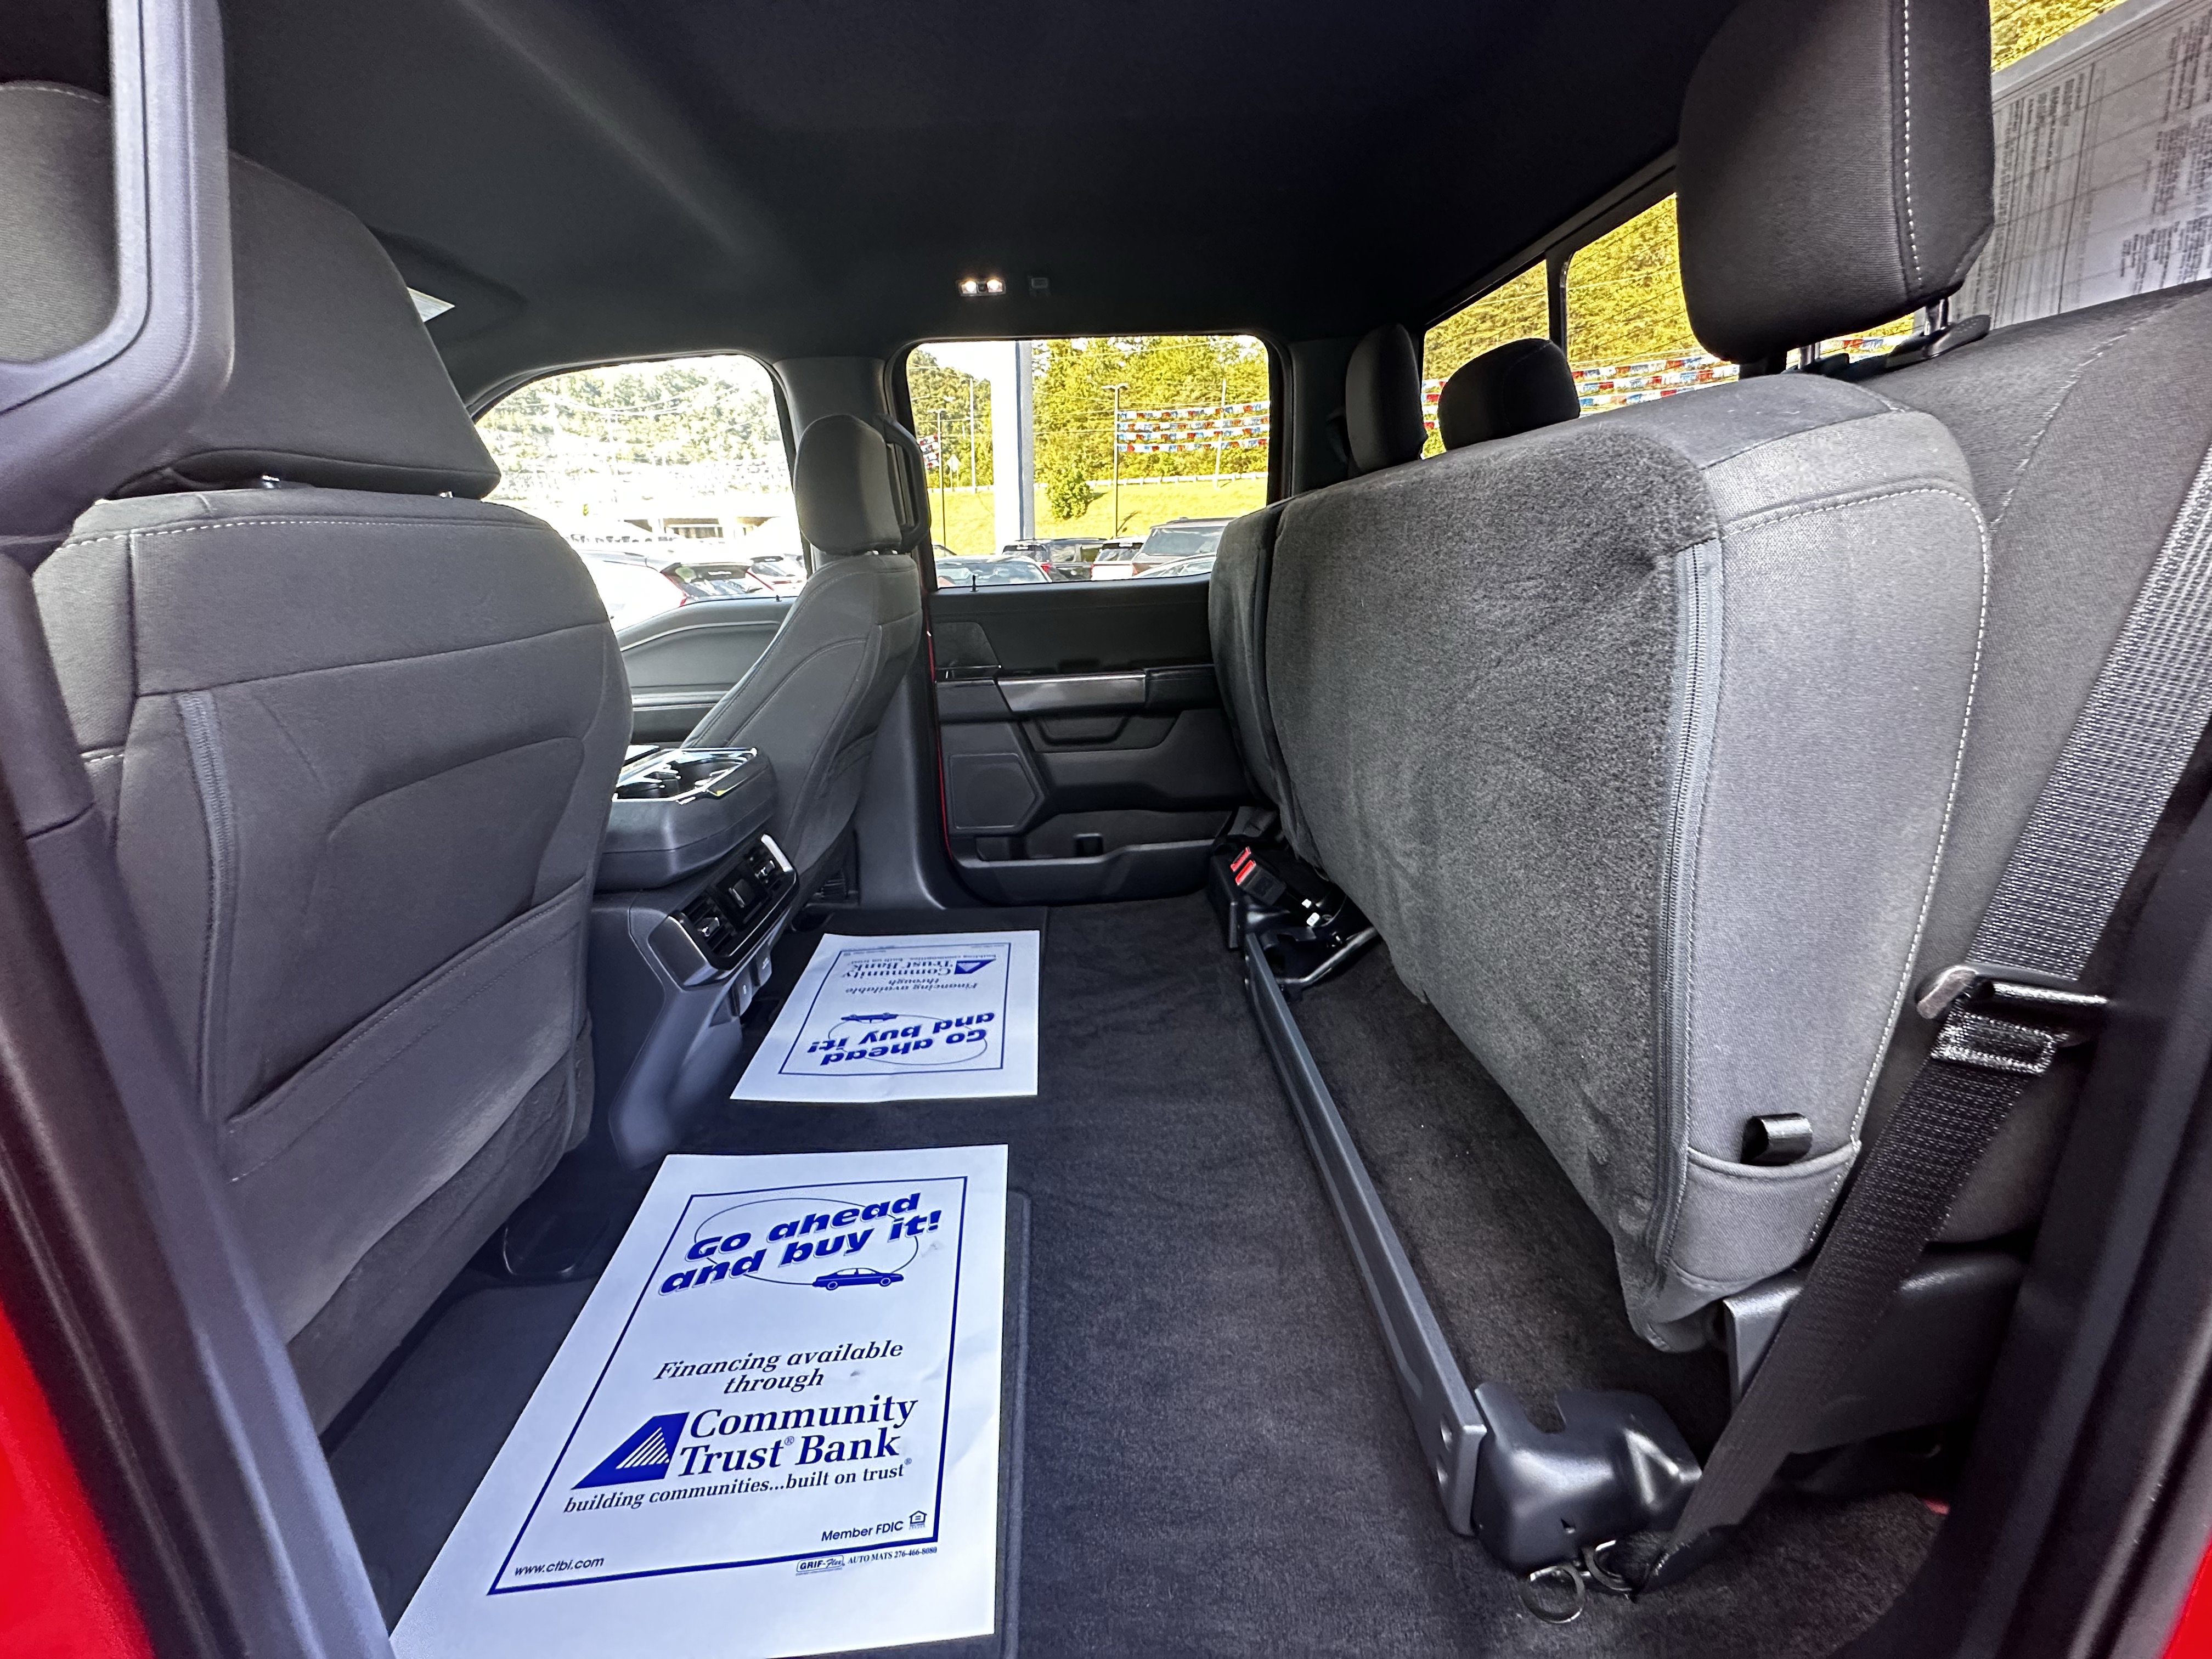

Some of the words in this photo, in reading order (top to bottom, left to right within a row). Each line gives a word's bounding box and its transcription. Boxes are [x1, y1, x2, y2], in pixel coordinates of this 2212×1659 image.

[841, 967, 951, 978] Community
[933, 1012, 995, 1033] and
[807, 1037, 849, 1053] it!
[859, 1024, 922, 1045] buy
[946, 1029, 987, 1045] Go
[820, 1038, 933, 1066] ahead
[685, 1232, 751, 1262] Go
[767, 1193, 921, 1242] ahead
[659, 1250, 765, 1296] and
[778, 1229, 873, 1267] buy
[888, 1210, 941, 1243] it!
[653, 1352, 781, 1380] Financing
[787, 1340, 903, 1367] available
[724, 1369, 825, 1394] through
[690, 1394, 918, 1439] Community
[795, 1428, 902, 1465] Bank
[563, 1491, 645, 1514] building
[834, 1472, 857, 1485] on
[821, 1526, 873, 1541] Member
[876, 1521, 903, 1534] FDIC
[514, 1557, 604, 1576] www.ctbi.com
[848, 1555, 870, 1564] AUTO
[871, 1551, 892, 1561] MATS
